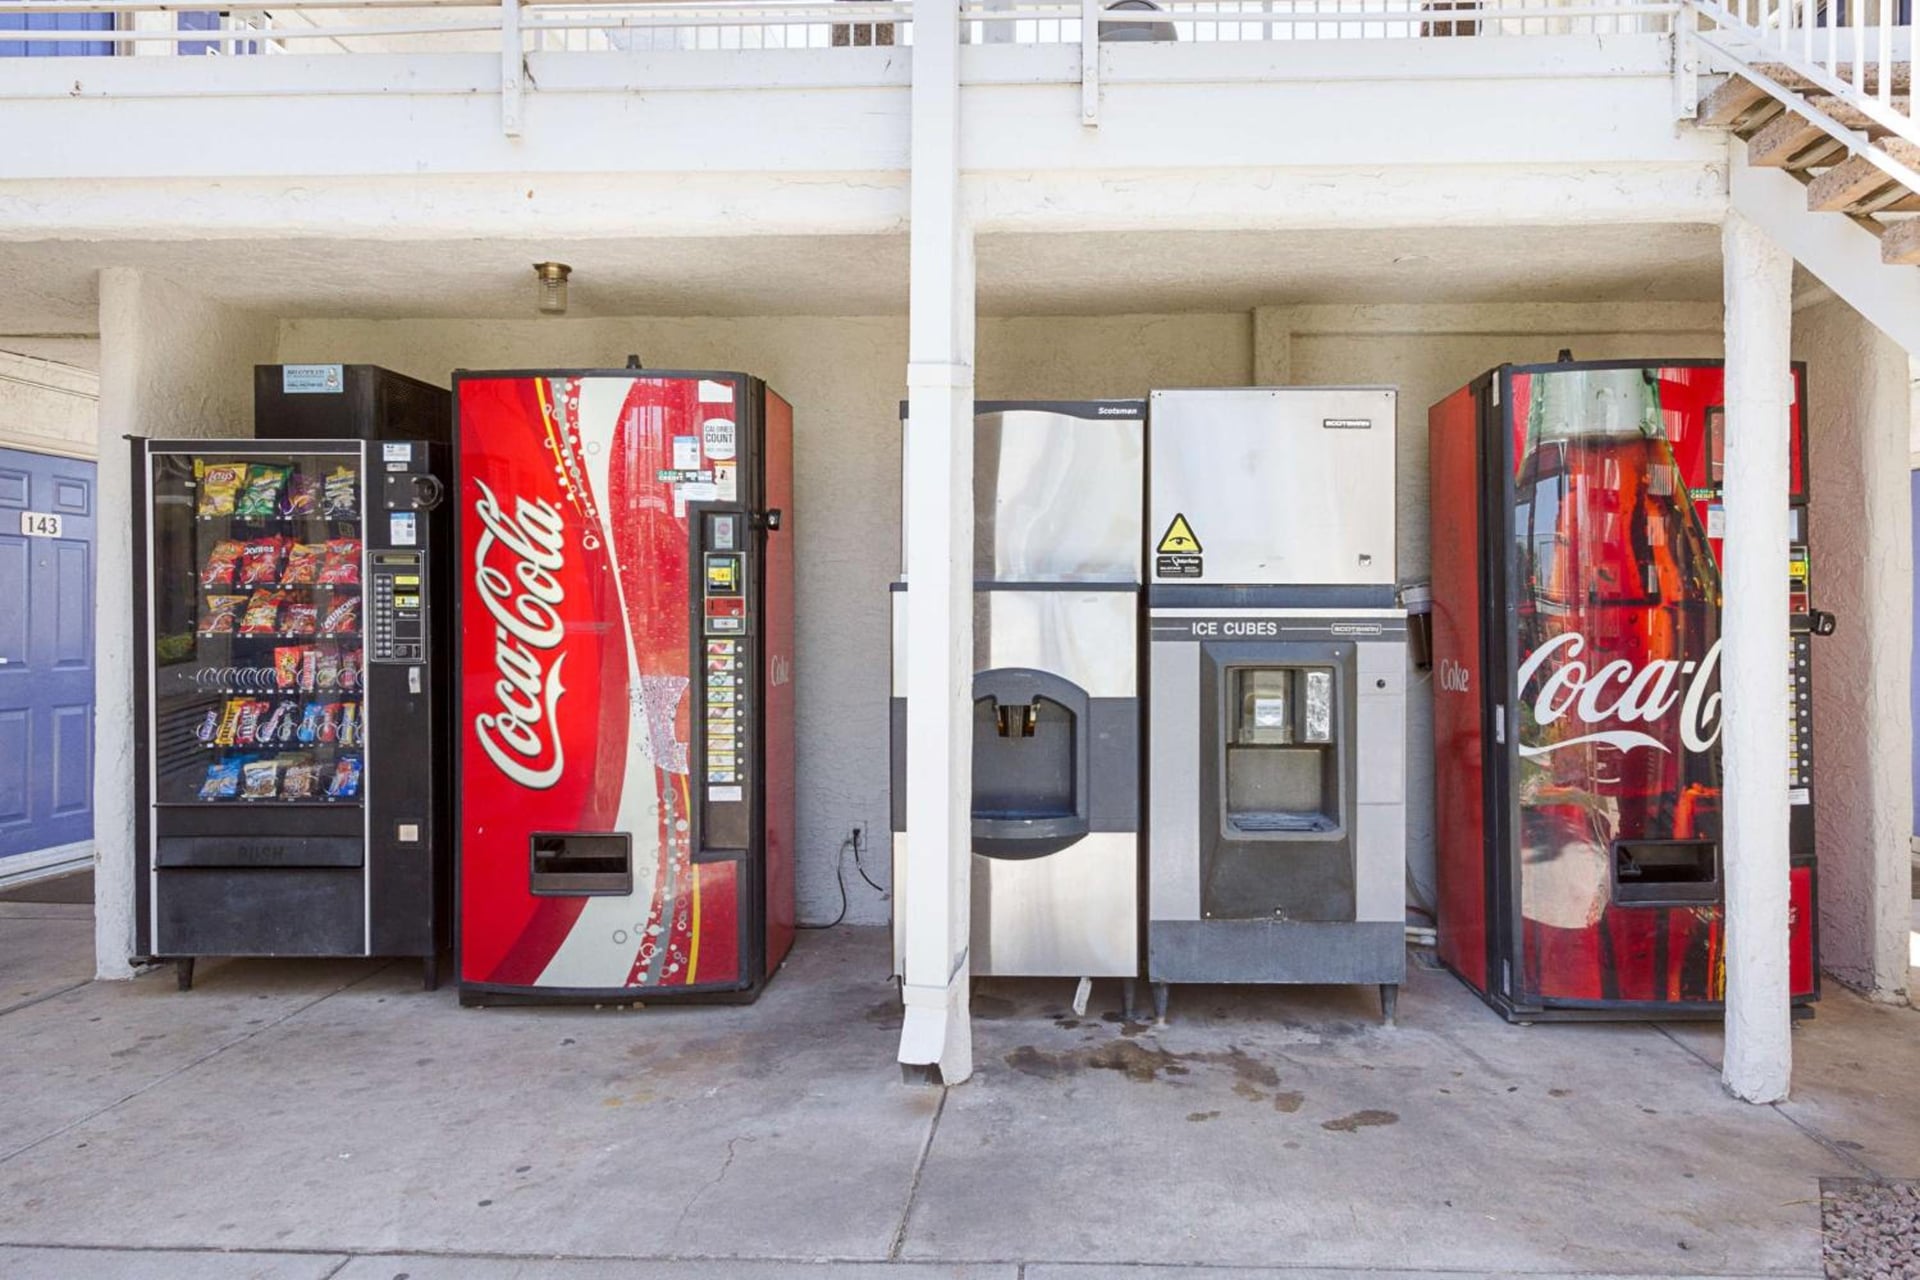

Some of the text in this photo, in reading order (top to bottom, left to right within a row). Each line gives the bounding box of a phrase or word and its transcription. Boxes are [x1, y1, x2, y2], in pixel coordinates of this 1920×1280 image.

[1098, 407, 1138, 415] Scotsman
[705, 433, 734, 443] COUNT
[27, 515, 58, 535] 143
[475, 476, 567, 790] Coca-Cola
[1191, 622, 1278, 636] ICE CUBES
[770, 654, 789, 687] Coke
[1440, 657, 1469, 692] Coke
